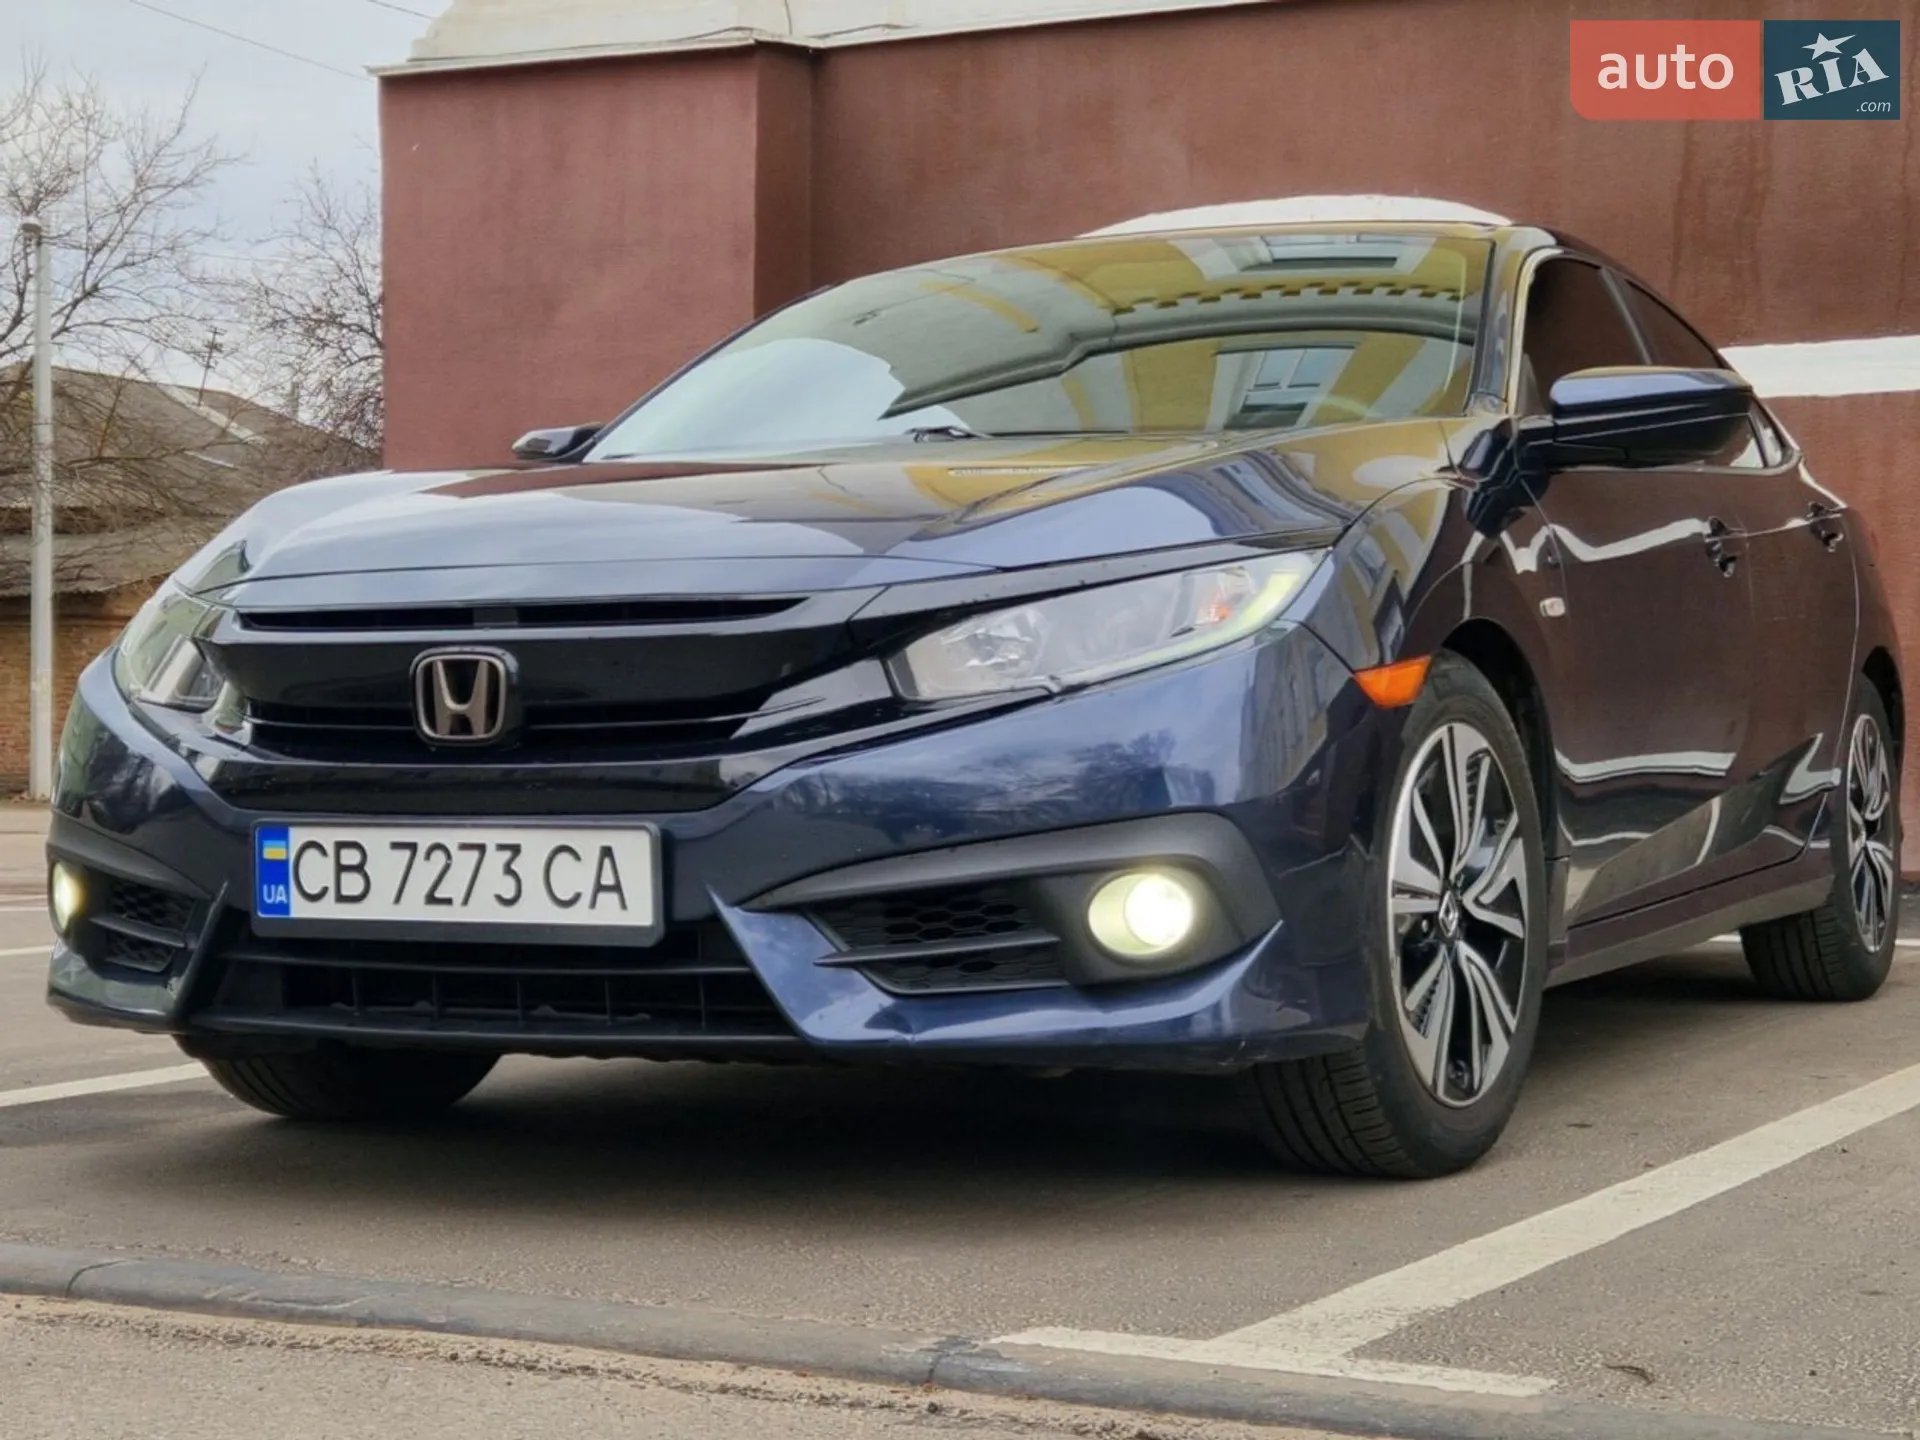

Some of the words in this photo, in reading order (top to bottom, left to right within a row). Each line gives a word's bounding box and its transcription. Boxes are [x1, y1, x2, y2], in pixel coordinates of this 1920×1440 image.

[262, 885, 288, 905] UA
[292, 840, 371, 904] CB
[390, 842, 522, 907] 7273
[542, 844, 628, 911] CA
